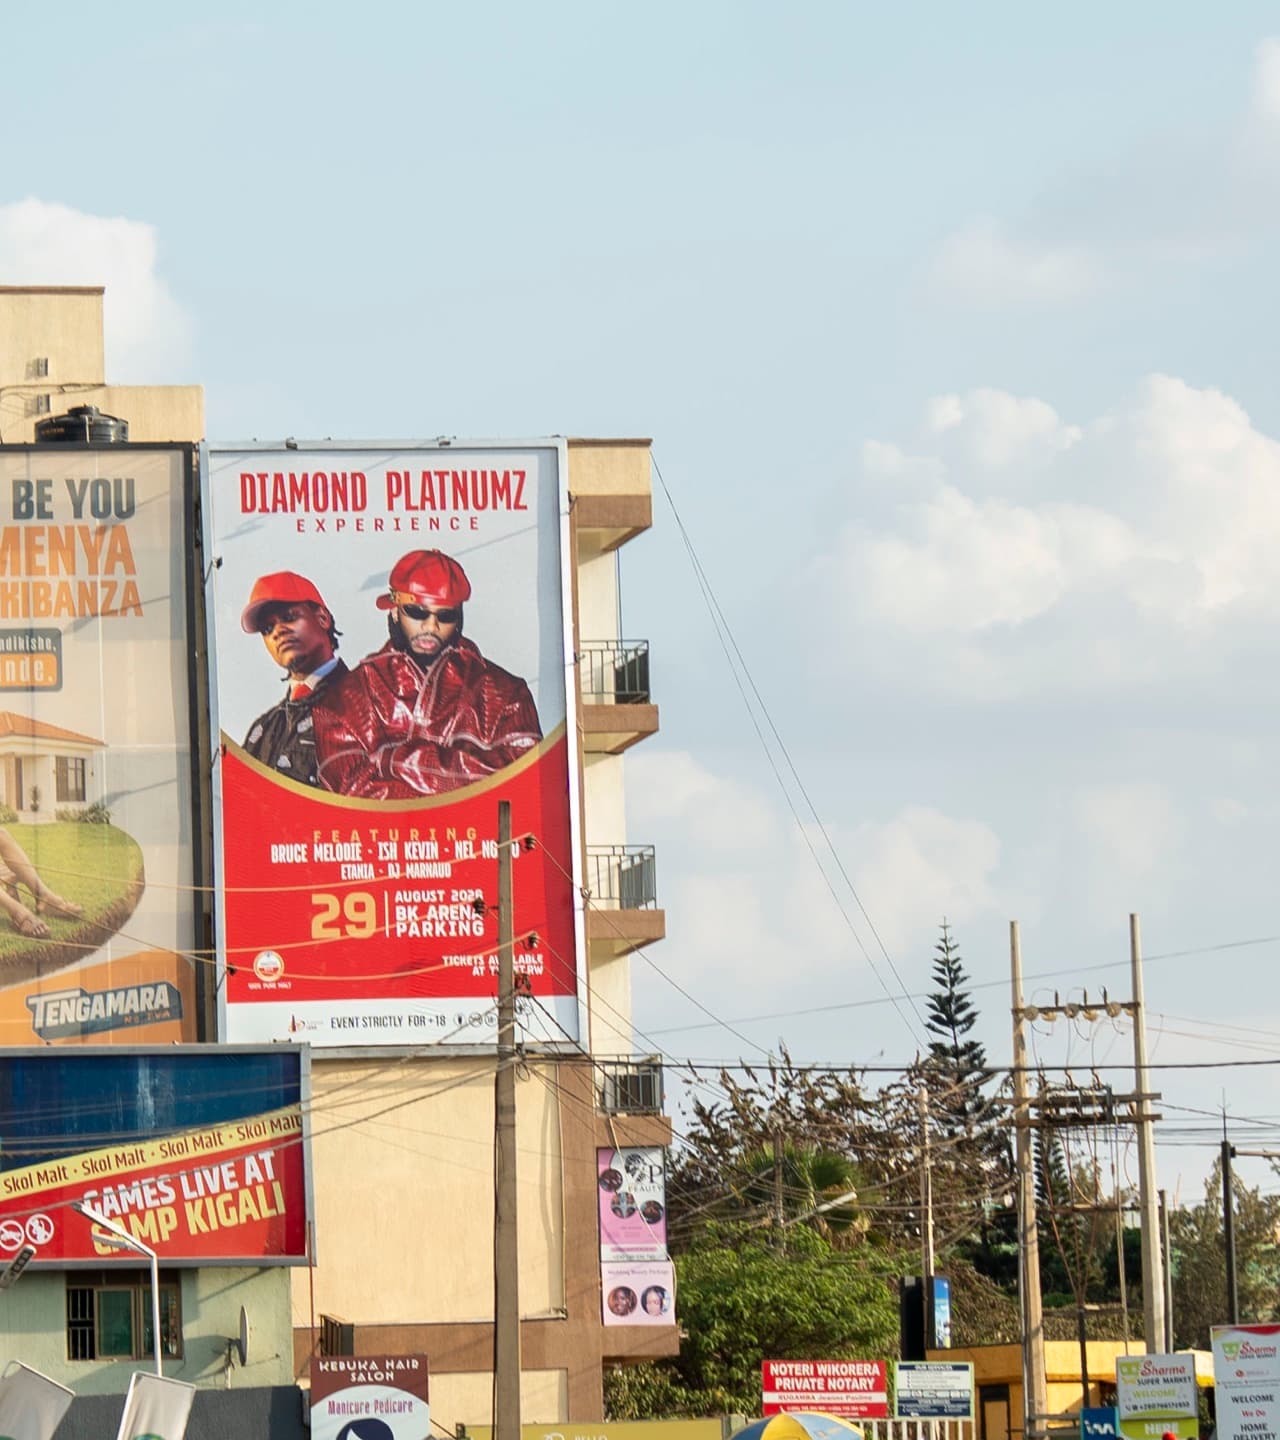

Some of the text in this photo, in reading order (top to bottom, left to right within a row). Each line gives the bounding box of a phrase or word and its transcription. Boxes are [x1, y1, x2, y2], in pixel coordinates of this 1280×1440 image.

[12, 479, 54, 521] BE
[65, 478, 136, 520] YOU
[240, 470, 528, 514] DIAMOND PLATNUMZ
[297, 516, 480, 533] EXPERIENCE
[313, 827, 478, 844] FEATURING
[271, 843, 308, 864] BRUCE
[314, 842, 362, 863] MELODIE
[378, 841, 397, 862] ISH
[404, 840, 439, 861] KEVIN
[455, 839, 477, 860] NEL
[341, 862, 452, 881] ETANIA DJ MARNAUD
[395, 889, 445, 903] AUGUST
[311, 891, 377, 940] 29
[395, 905, 420, 922] BK
[395, 920, 485, 938] PARKING
[442, 953, 544, 968] TICKETS AVLABLE
[472, 966, 485, 977] AT
[27, 983, 171, 1030] TENGAMARA
[330, 1015, 361, 1029] EVENT
[361, 1014, 404, 1029] STRICTLY
[408, 1015, 427, 1027] FOR
[3, 1172, 34, 1194] Skol
[37, 1165, 69, 1187] Malt
[81, 1156, 112, 1176] Skol
[115, 1149, 147, 1169] Malt
[158, 1139, 190, 1159] Skol
[192, 1132, 224, 1152] Malt
[236, 1121, 268, 1142] Skol
[270, 1113, 302, 1134] Malt
[83, 1149, 276, 1218] GAMES LIVE AT
[184, 1180, 287, 1237] KIGALI
[1240, 1340, 1277, 1355] Sharma
[385, 1358, 420, 1370] HAIR
[770, 1363, 881, 1377] NOTERI WIKORERA
[1140, 1360, 1186, 1377] Sharma
[350, 1370, 395, 1383] SALON
[775, 1377, 876, 1391] PRIVATE NOTARY
[1137, 1376, 1192, 1386] SUPER MARKET
[1231, 1393, 1275, 1403] WELCOME
[1240, 1423, 1269, 1433] HOME
